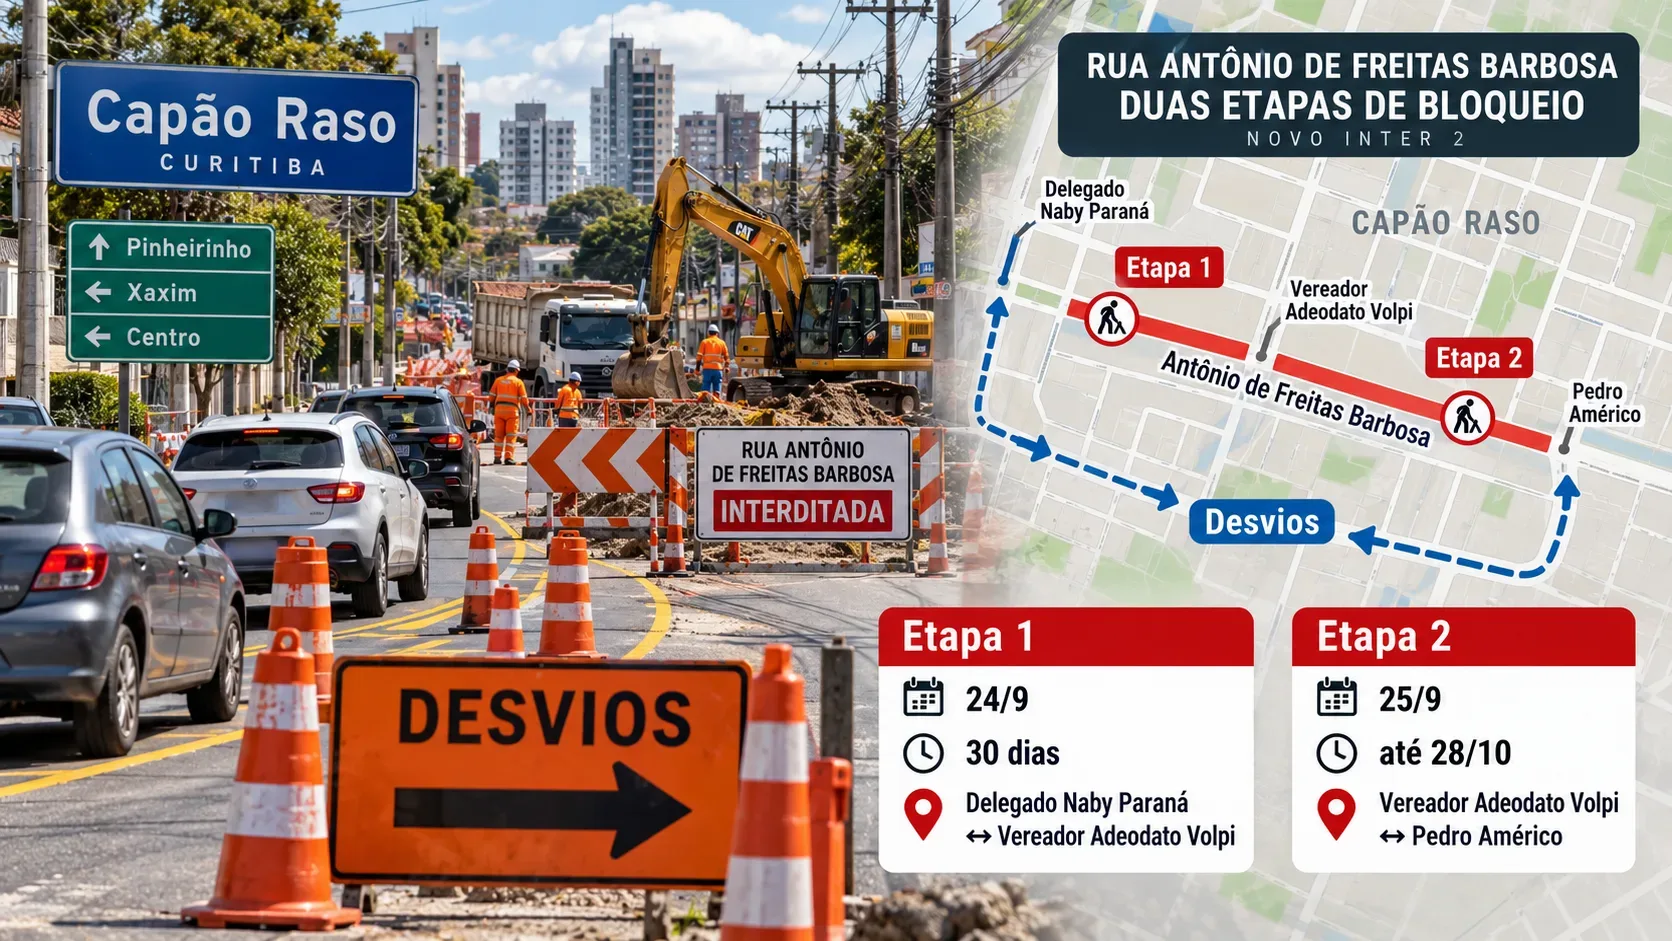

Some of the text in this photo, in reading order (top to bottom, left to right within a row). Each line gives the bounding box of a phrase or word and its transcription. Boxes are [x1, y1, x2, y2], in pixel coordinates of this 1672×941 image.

[88, 89, 395, 144] Capão Raso
[161, 154, 324, 175] CURITIBA
[735, 222, 754, 242] CAT
[128, 238, 251, 258] Pinheirinho
[128, 283, 196, 301] Xaxim
[128, 328, 200, 346] Centro
[743, 437, 864, 458] RUA ANTÔNIO
[713, 465, 894, 482] DE FREITAS BARBOSA
[721, 499, 885, 524] INTERDITADA
[399, 689, 690, 747] DESVIOS
